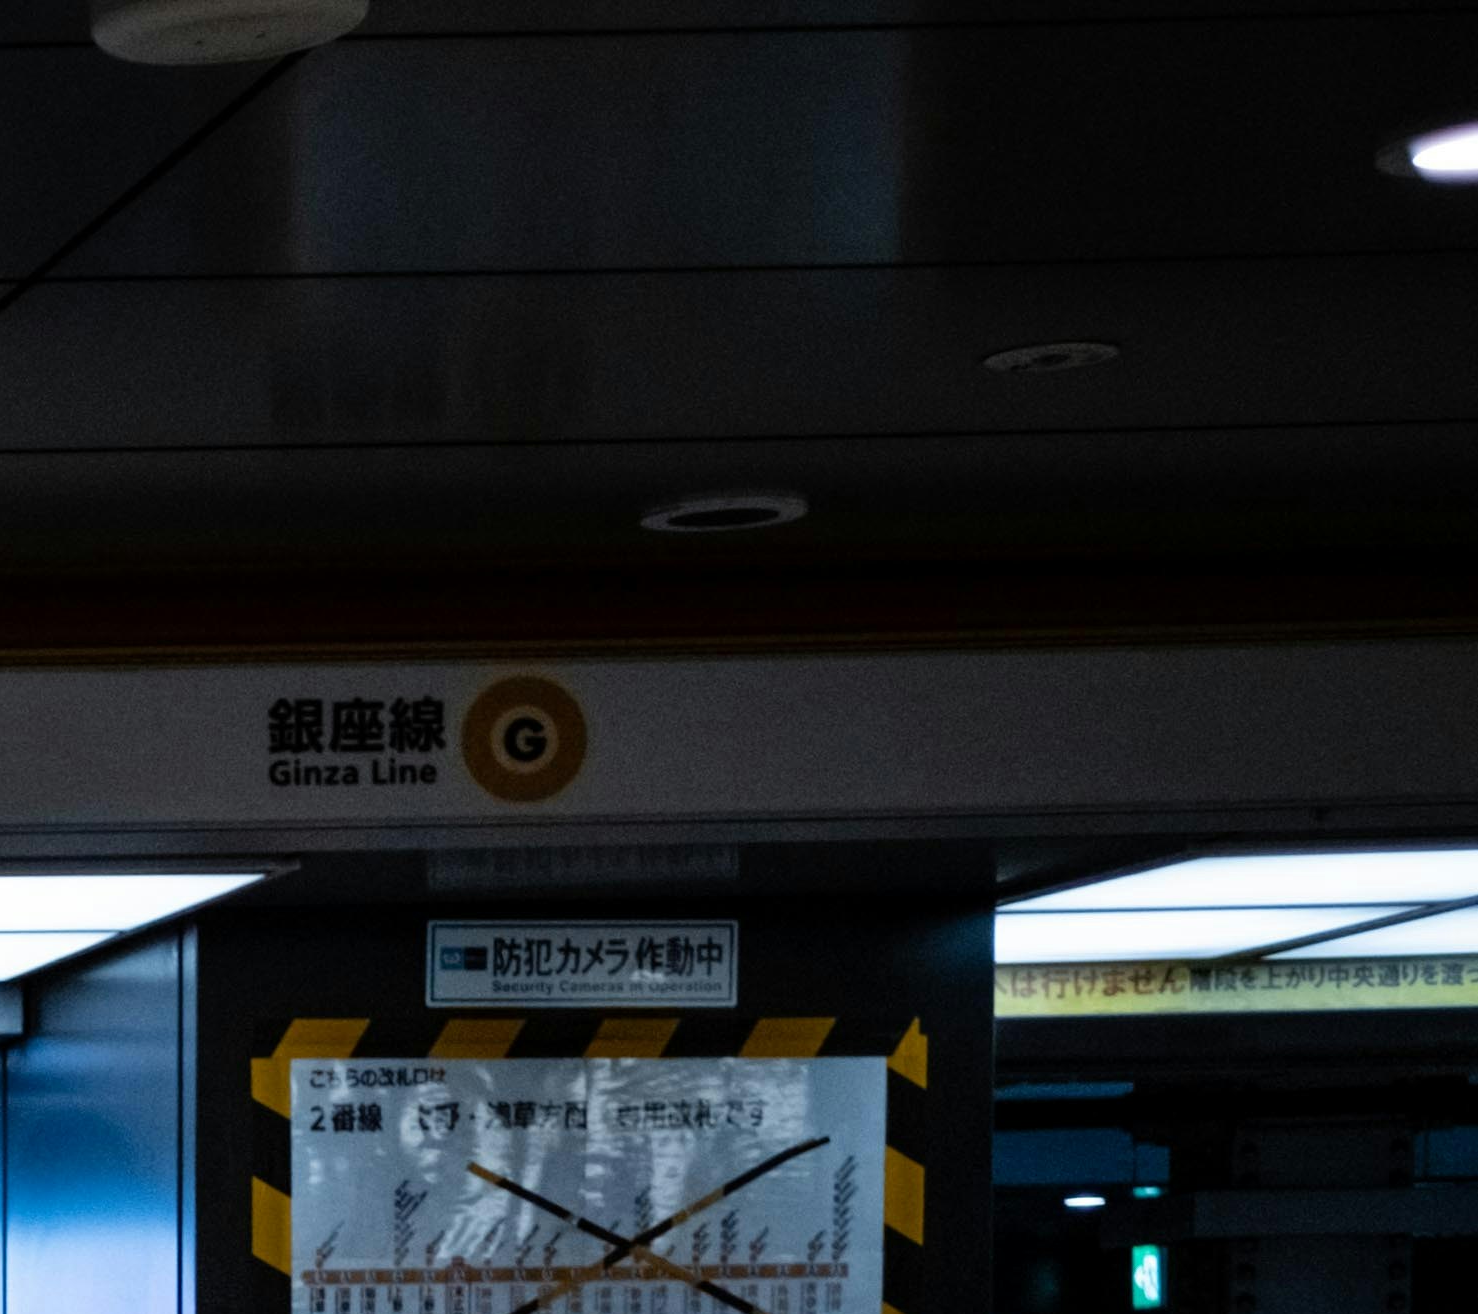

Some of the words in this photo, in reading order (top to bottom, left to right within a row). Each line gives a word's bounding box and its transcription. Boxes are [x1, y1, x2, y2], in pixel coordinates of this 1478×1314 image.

[267, 698, 446, 755] 銀座線
[503, 717, 548, 763] G
[268, 758, 359, 787] Ginza
[371, 757, 437, 785] Line
[491, 936, 724, 978] 防犯カメラ作動中
[491, 980, 554, 995] Security
[558, 979, 625, 993] Cameras
[649, 979, 724, 995] Operation
[309, 1105, 383, 1132] 2番線
